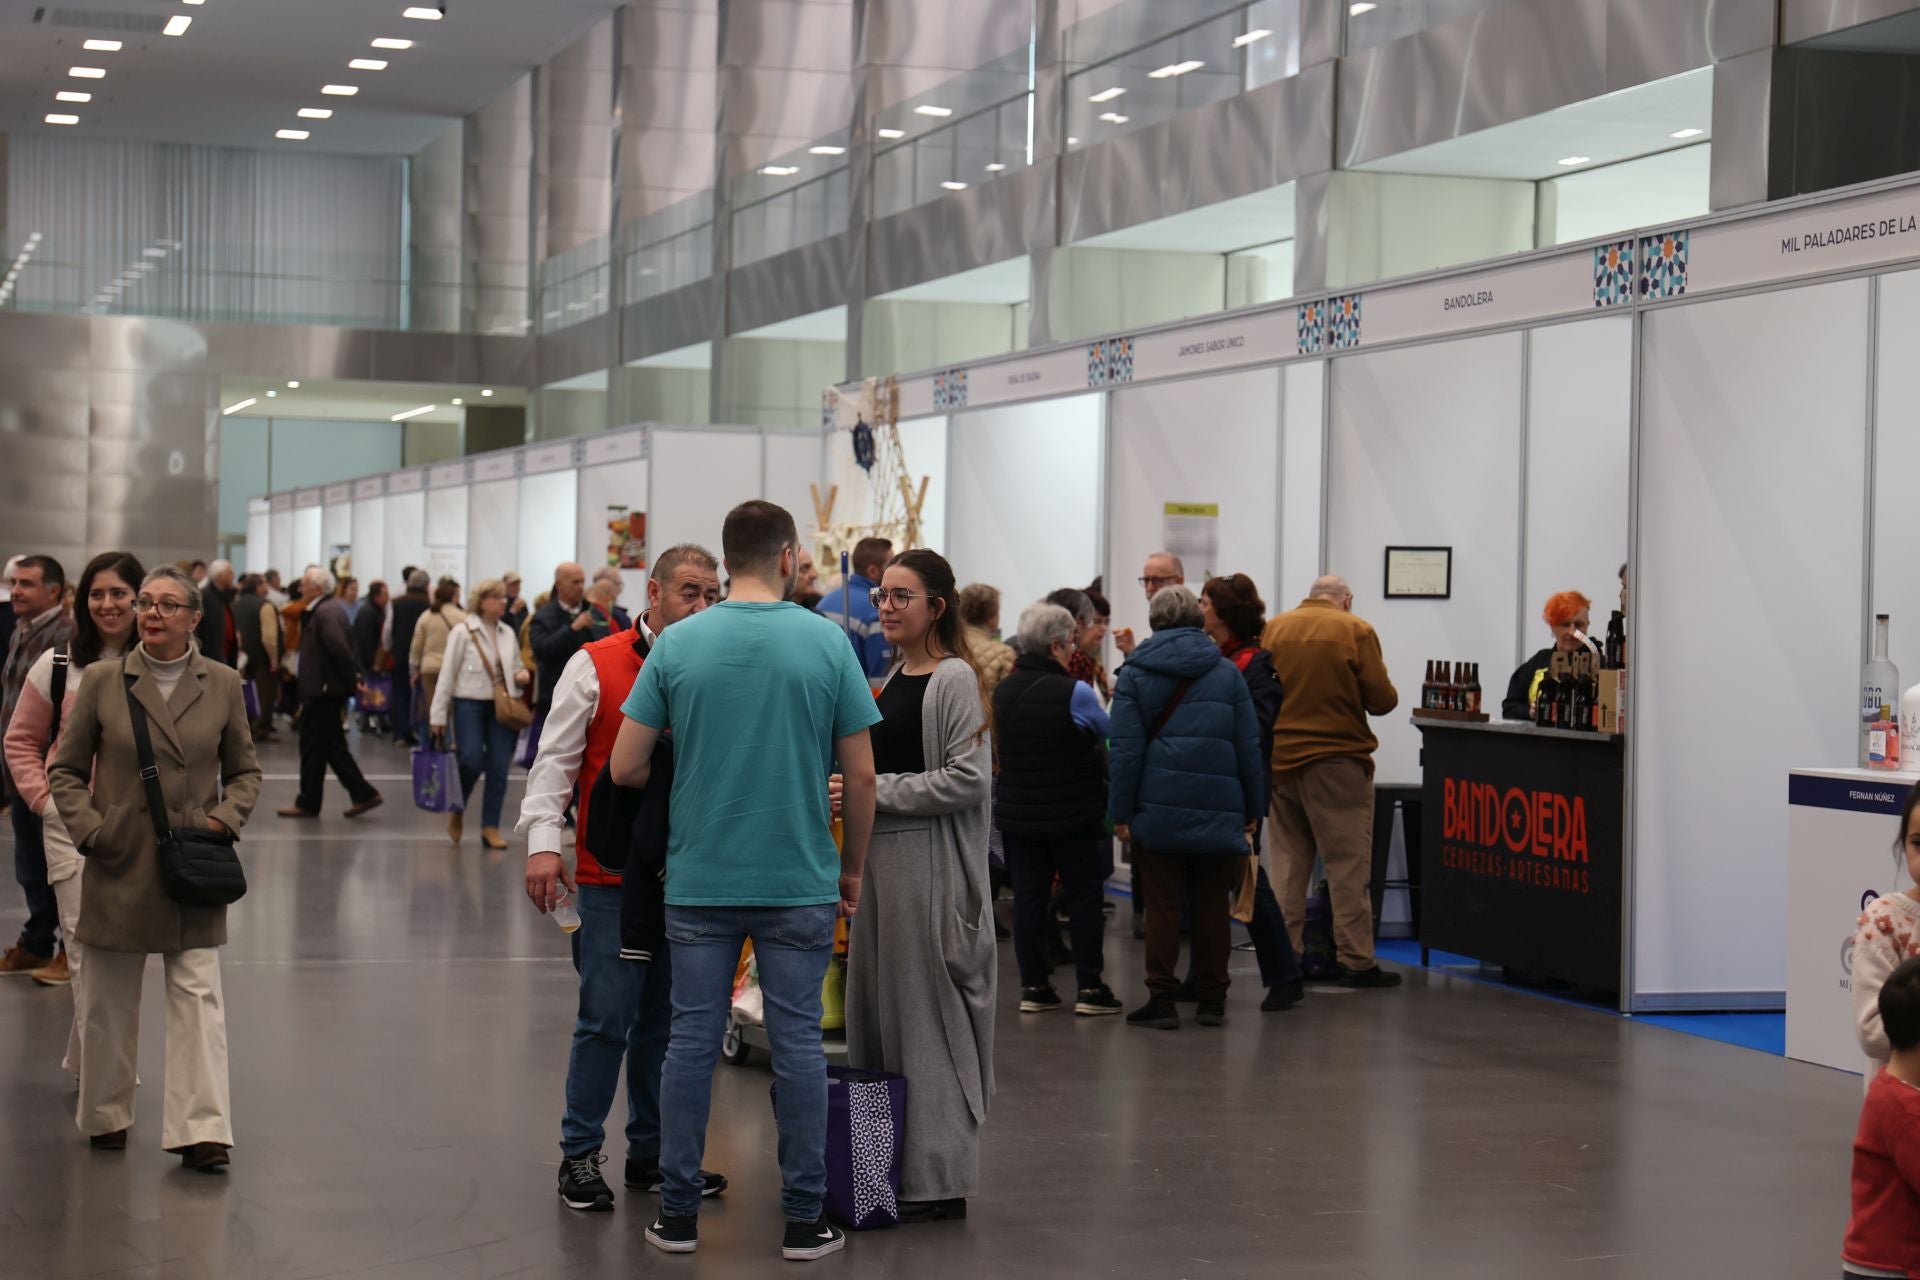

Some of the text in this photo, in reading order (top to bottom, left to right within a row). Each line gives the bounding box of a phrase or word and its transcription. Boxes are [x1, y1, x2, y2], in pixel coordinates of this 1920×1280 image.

[1781, 215, 1917, 254] MIL PALADARES DE LA
[1444, 290, 1493, 311] BANDOLERA
[1849, 790, 1895, 803] FERNAN NÚÑEZ
[1443, 777, 1589, 864] BANDOLERA
[1443, 845, 1589, 894] CERVEZAS ARTESANAS
